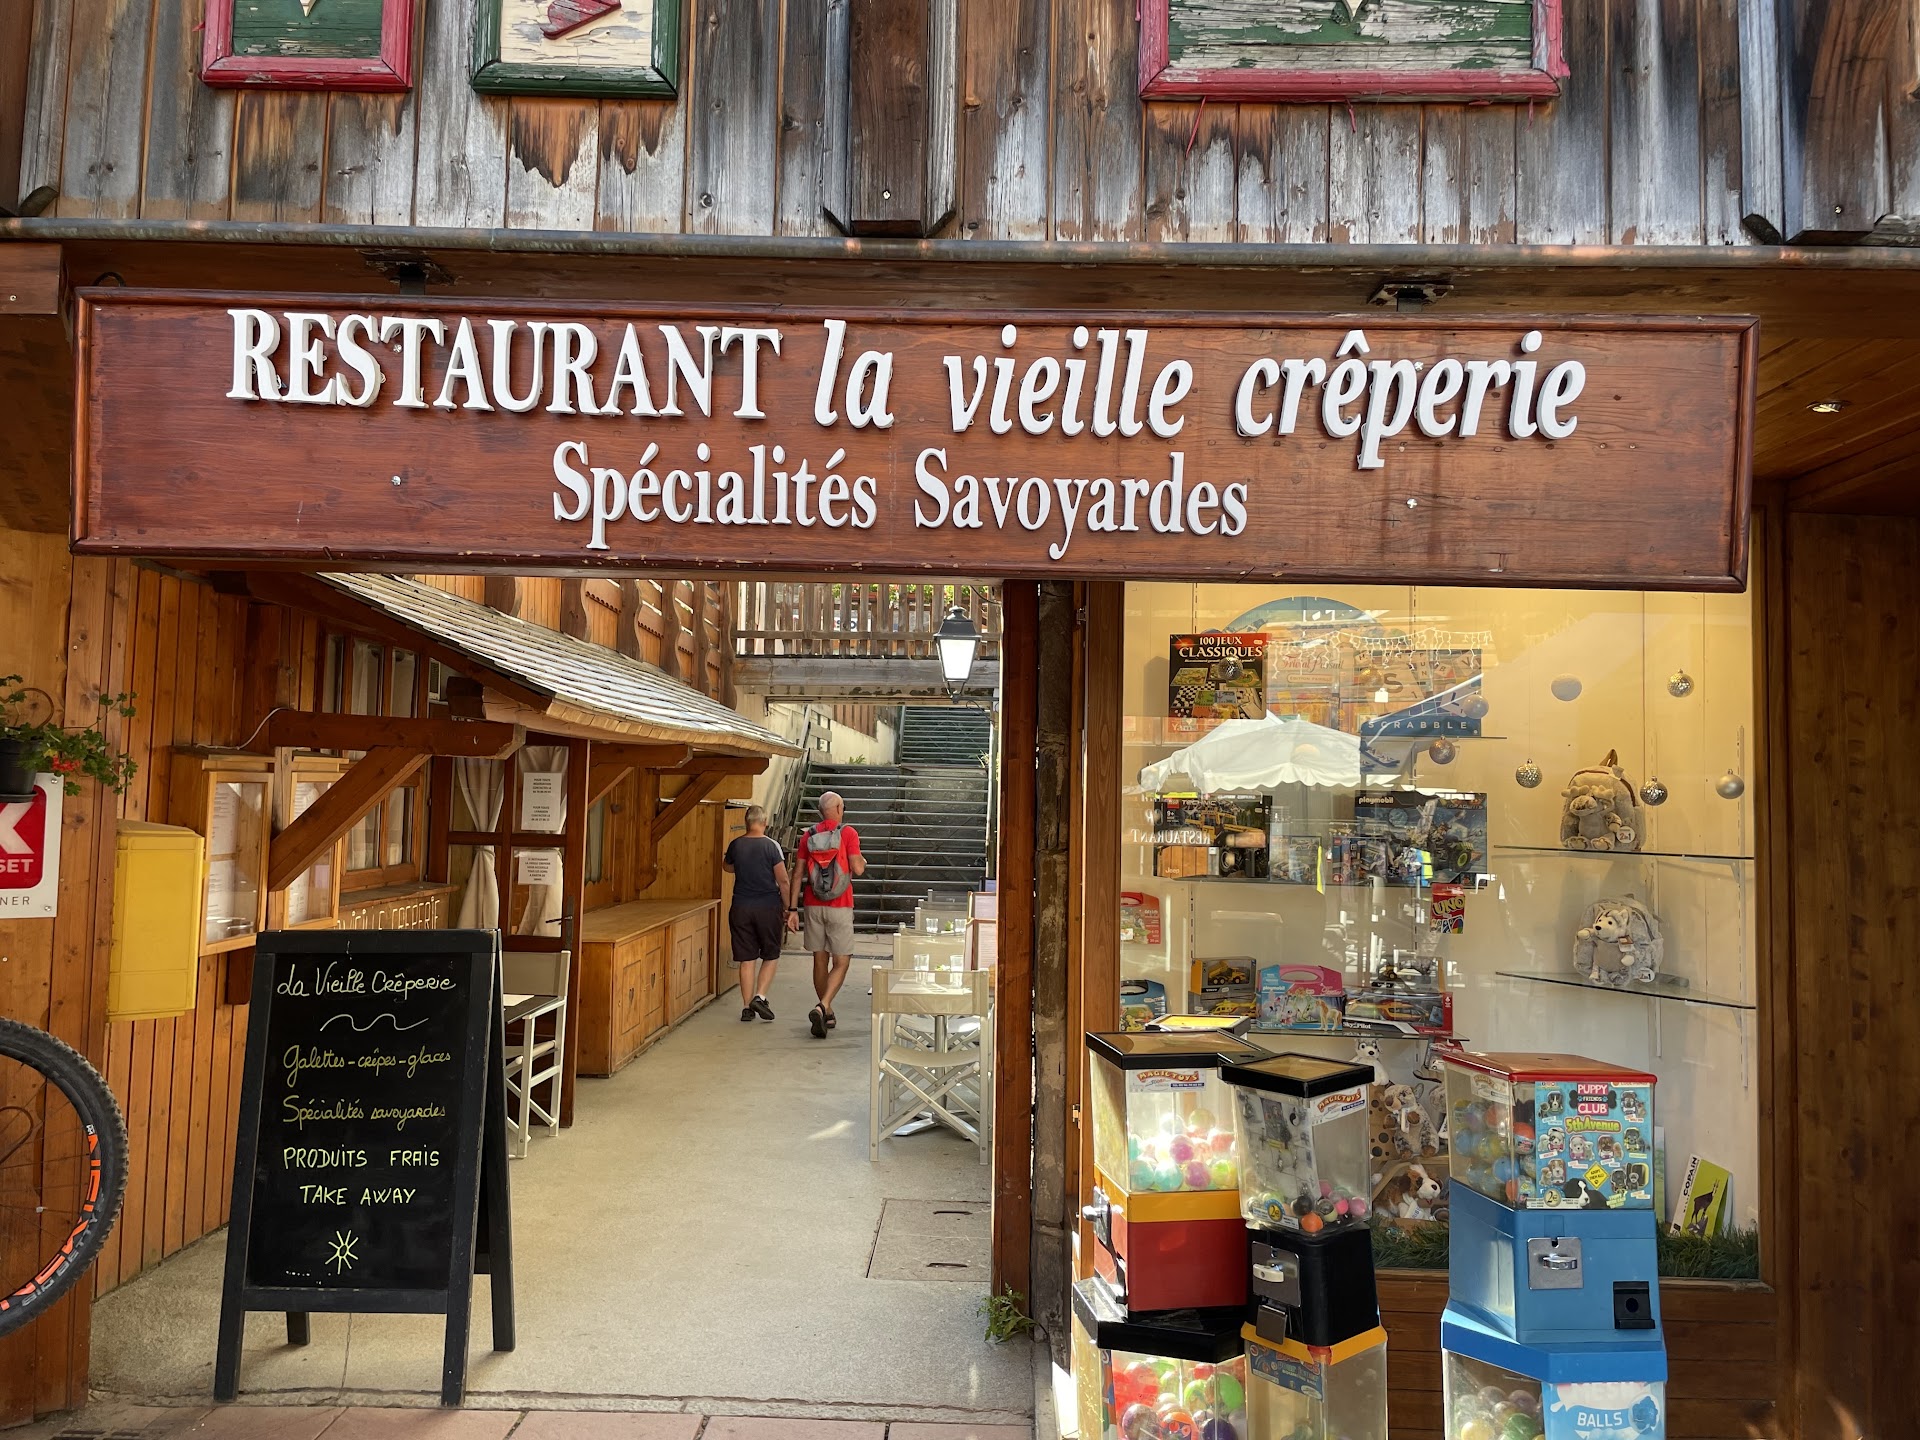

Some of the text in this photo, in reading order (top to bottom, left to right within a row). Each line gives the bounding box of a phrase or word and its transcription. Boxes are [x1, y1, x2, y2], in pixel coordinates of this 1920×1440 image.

[226, 308, 1586, 470] RESTAURANT la vieille crêperie
[552, 441, 1249, 560] Spécialités Savoyardes
[1199, 636, 1243, 647] 100 JEUX
[1178, 646, 1263, 658] CLASSIQUES
[1368, 721, 1467, 729] SCRABBLE
[1358, 796, 1394, 805] playmobil
[1165, 867, 1180, 875] Jeep
[1432, 895, 1466, 917] UNO
[277, 963, 310, 997] La
[316, 961, 366, 996] Vieille
[1577, 1084, 1608, 1094] PUPPY
[283, 1095, 447, 1131] Spécialités savoyardes
[1577, 1103, 1608, 1114] CLUB
[284, 1144, 440, 1169] PRODUITS FRAIS
[1683, 1157, 1698, 1197] COPAIN
[300, 1185, 416, 1206] TAKE AWAY
[1577, 1412, 1623, 1428] BALLS
